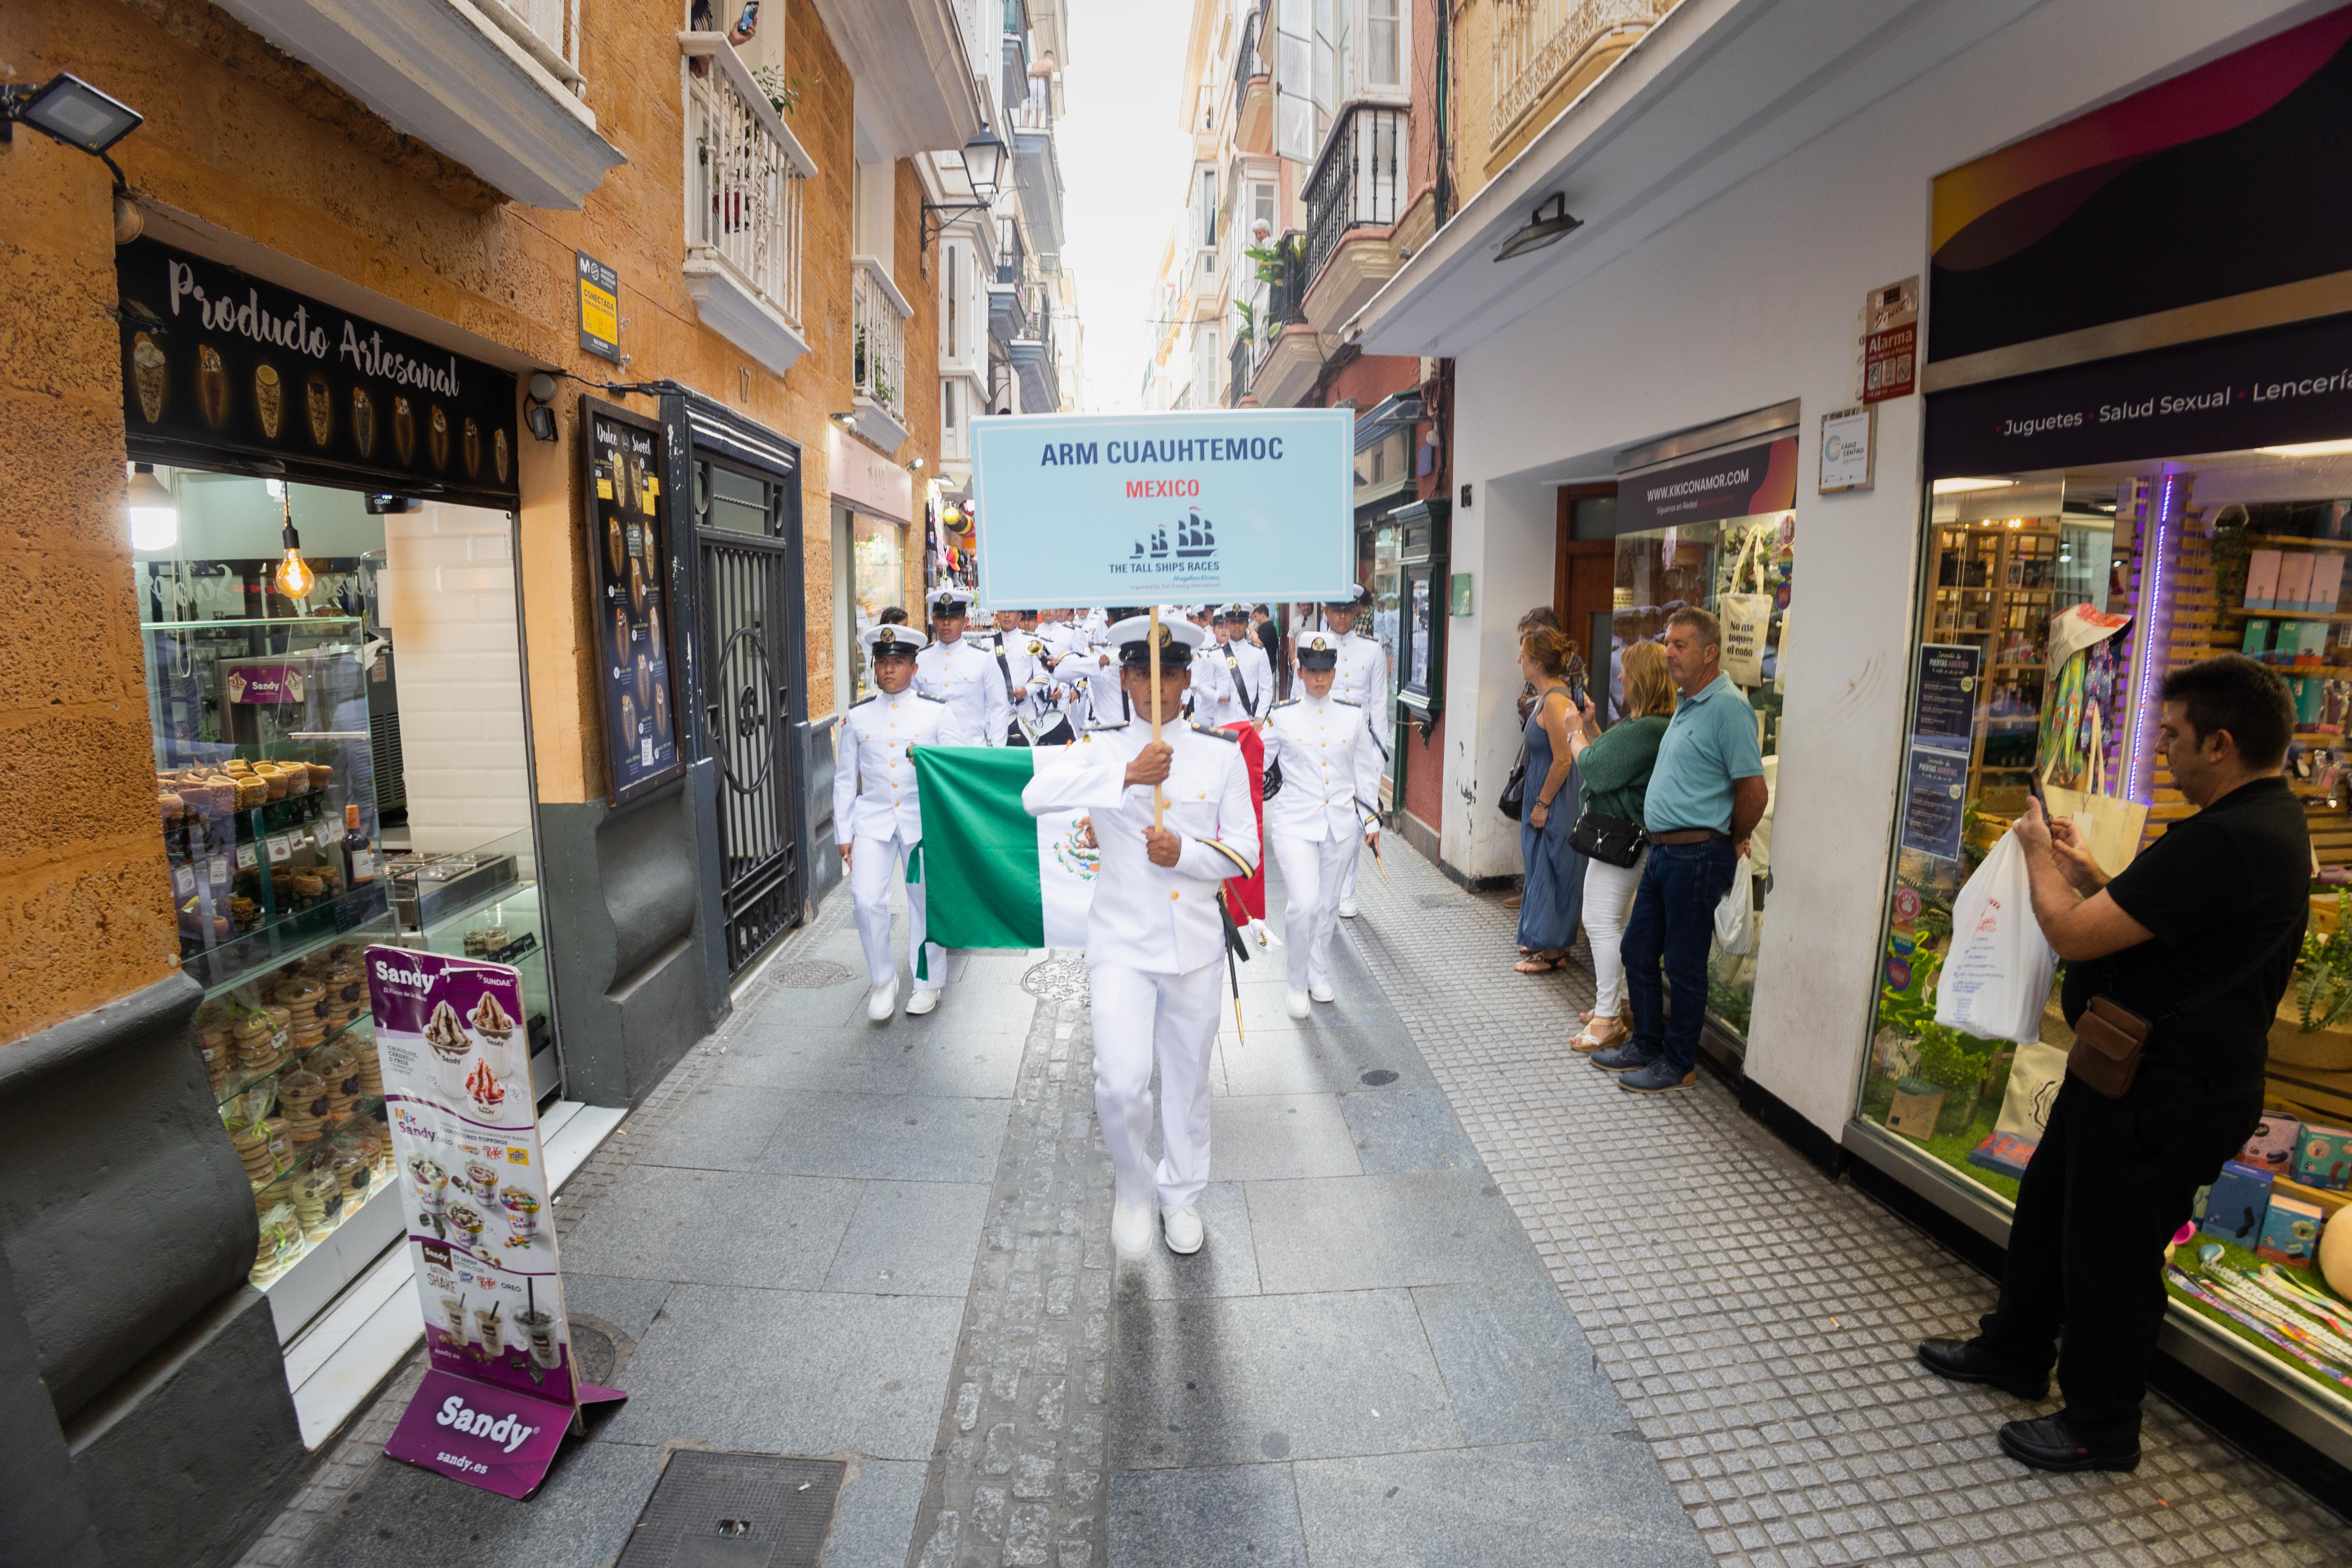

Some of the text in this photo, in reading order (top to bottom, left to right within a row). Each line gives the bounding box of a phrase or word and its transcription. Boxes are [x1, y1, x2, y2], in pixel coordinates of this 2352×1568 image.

[584, 288, 614, 312] CONECTADA
[169, 259, 460, 397] Producto Artesanal
[1869, 330, 1912, 353] Alarma
[739, 365, 751, 403] 17
[2003, 410, 2083, 437] Juguetes
[2099, 397, 2154, 423] Salud
[2159, 386, 2232, 415] Sexual
[597, 422, 651, 455] Dulce Sweet
[1041, 436, 1284, 466] ARM CUAUHTEMOC
[1843, 447, 1864, 457] CENTRO
[1126, 479, 1200, 499] MEXICO
[1647, 468, 1749, 502] WWW.KIKICONAMOR.COM
[1109, 561, 1220, 574] THE TALL SHIPS RACES
[1730, 620, 1754, 632] No me
[1729, 633, 1754, 645] toques
[1727, 644, 1753, 657] el coño
[1929, 658, 1948, 668] PUERTAS
[252, 681, 279, 691] Sandy
[477, 971, 511, 987] by SUNDAE
[486, 1038, 504, 1048] Sandy
[442, 1055, 461, 1065] Sandy
[394, 1107, 416, 1125] Mix
[478, 1106, 495, 1116] Sandy
[398, 1121, 435, 1143] Sandy
[508, 1214, 524, 1222] Mix
[424, 1247, 449, 1263] Sandy
[427, 1273, 458, 1294] SHAKE
[501, 1283, 521, 1292] OREO
[437, 1450, 488, 1474] sandy.es
